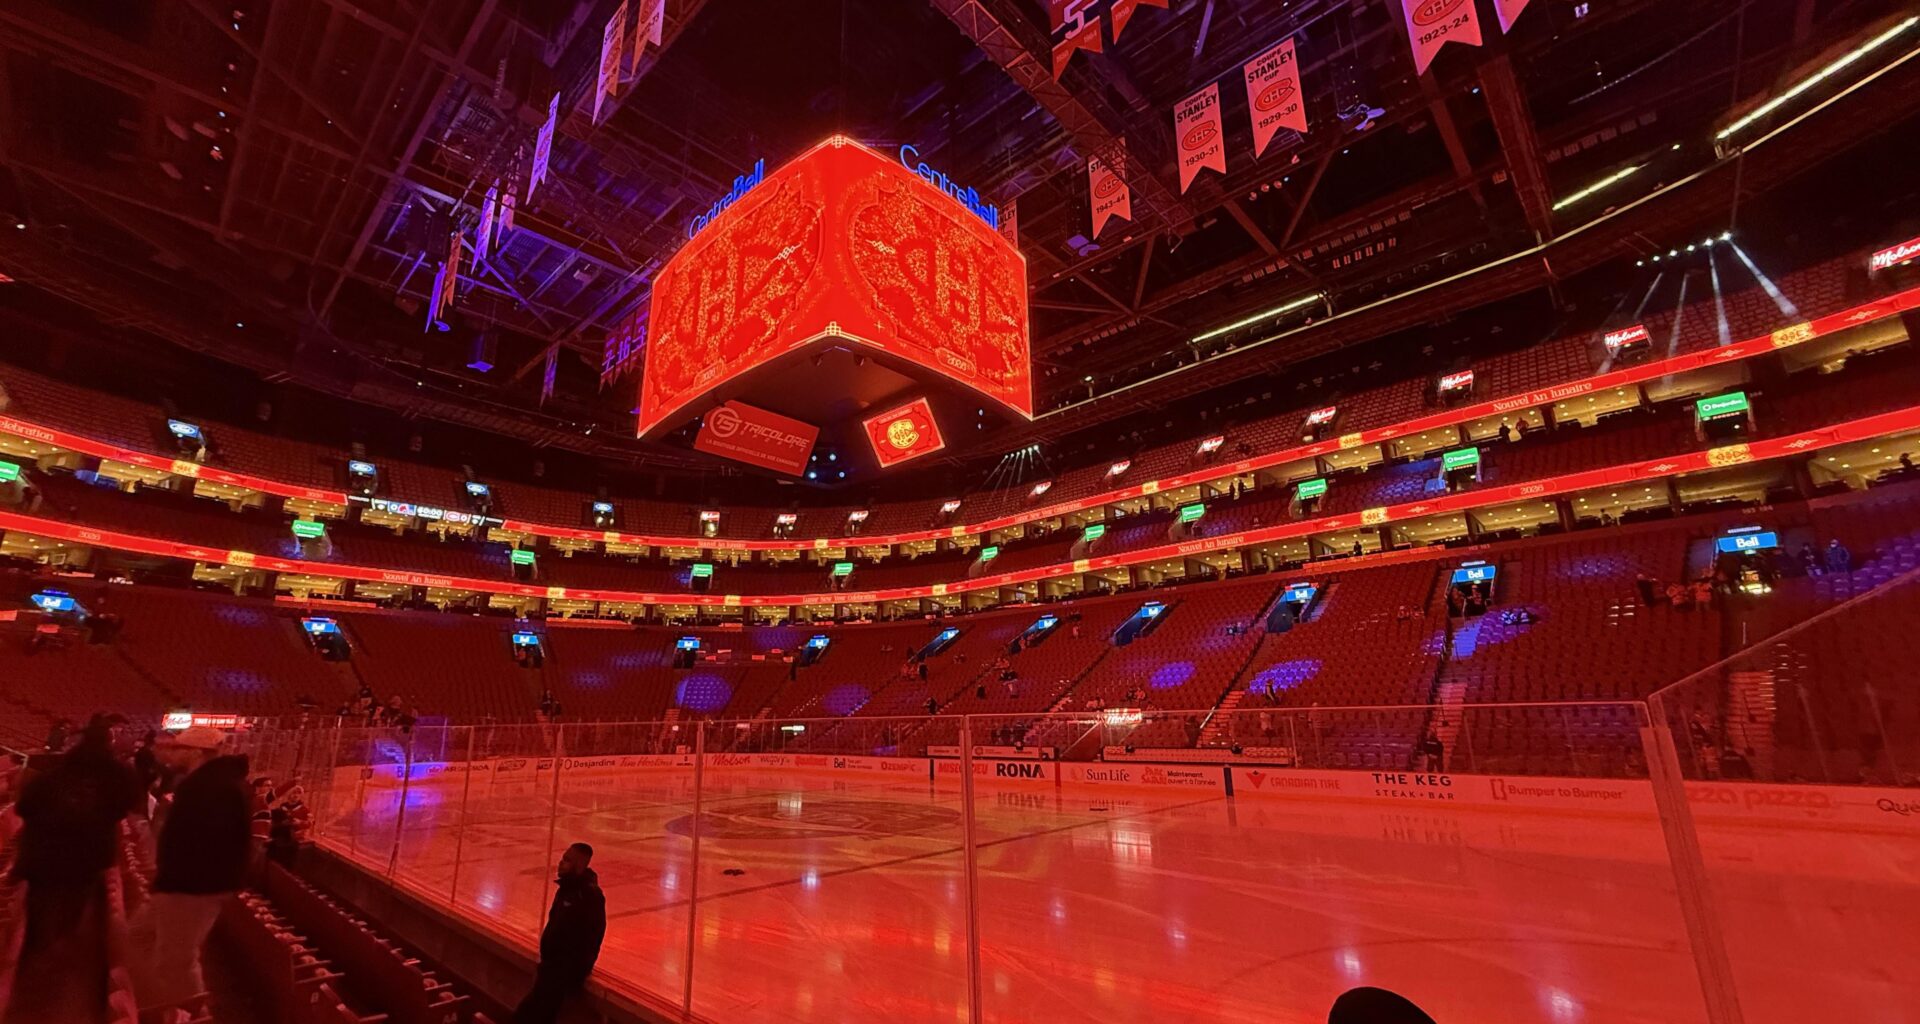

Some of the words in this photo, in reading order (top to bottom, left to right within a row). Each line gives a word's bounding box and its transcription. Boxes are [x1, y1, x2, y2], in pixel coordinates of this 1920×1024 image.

[1417, 14, 1470, 45] 1923-24
[1257, 48, 1282, 66] COUPE
[1247, 49, 1293, 83] STANLEY
[1263, 70, 1279, 82] CUP
[1184, 91, 1207, 107] COUPE
[1176, 93, 1217, 123] STANLEY
[1258, 103, 1298, 129] 1929-30
[1190, 112, 1205, 122] CUP
[1184, 144, 1219, 167] 1930-31
[1096, 193, 1126, 214] 1943-44
[1605, 329, 1647, 347] Molson
[1441, 373, 1473, 389] Molson
[1493, 396, 1529, 411] Nouvel
[1533, 392, 1547, 403] An
[1551, 383, 1592, 399] lunaire
[744, 421, 810, 448] TRICOLORE
[1205, 541, 1215, 549] An
[1736, 536, 1760, 548] Bell
[1467, 568, 1484, 578] Bell
[573, 757, 616, 769] Desjardins
[712, 754, 751, 766] Molson
[996, 762, 1045, 778] RONA
[1086, 768, 1107, 781] Sun
[1110, 768, 1130, 782] Life
[1167, 770, 1203, 778] Maintenant
[1270, 776, 1318, 789] CANADIAN
[1319, 778, 1341, 790] TIRE
[1371, 773, 1408, 785] THE
[1415, 774, 1452, 787] KEG
[1375, 789, 1416, 798] STEAK
[1428, 791, 1455, 800] BAR
[1508, 784, 1556, 797] Bumper
[1558, 787, 1571, 797] to
[1572, 787, 1623, 800] Bumper
